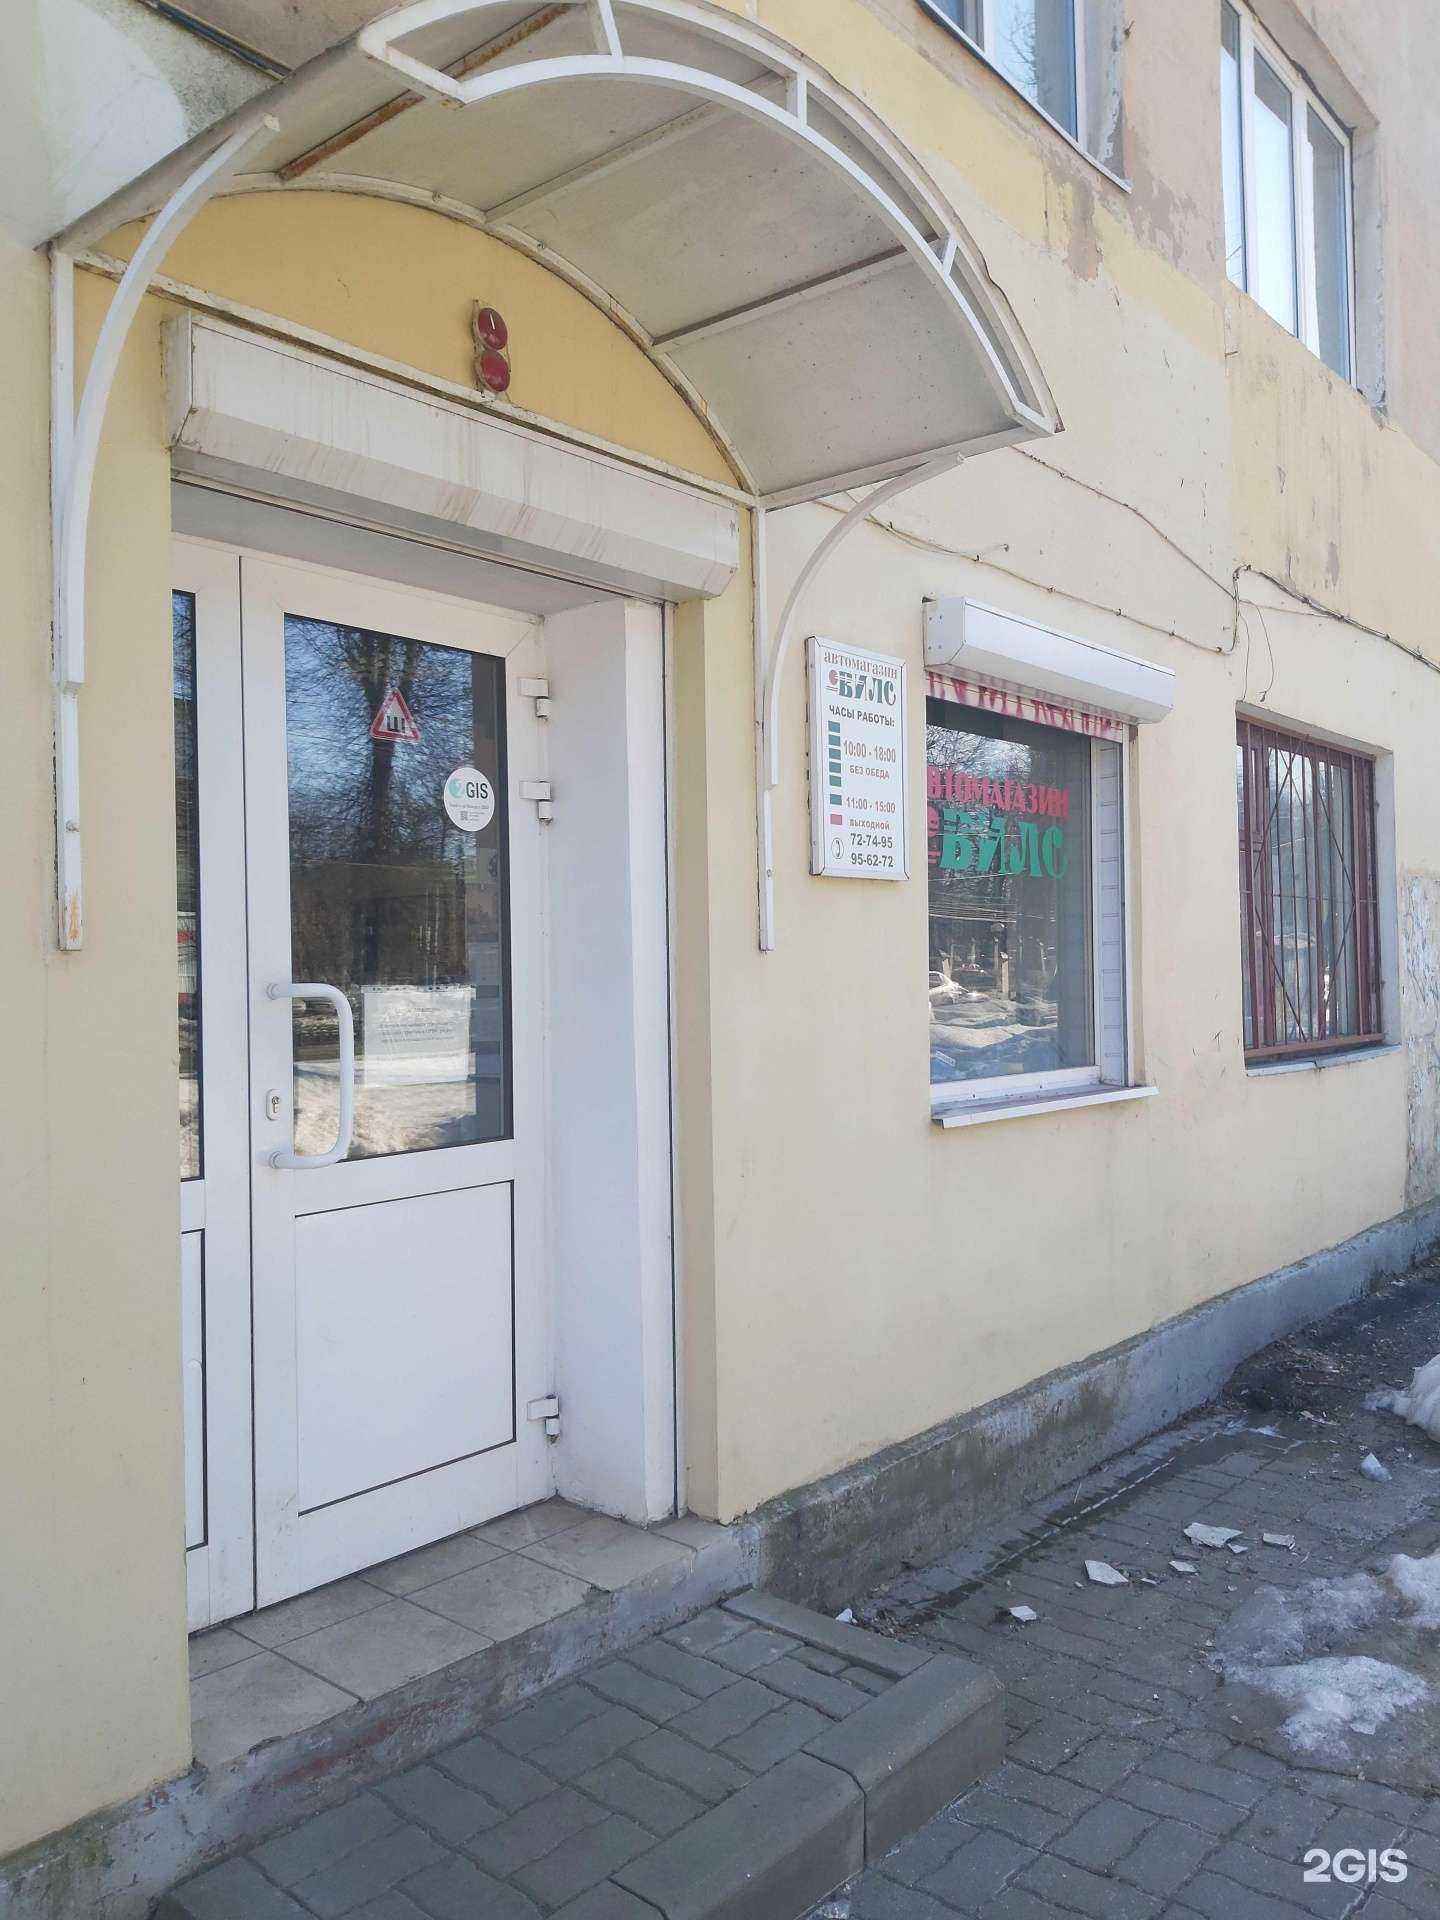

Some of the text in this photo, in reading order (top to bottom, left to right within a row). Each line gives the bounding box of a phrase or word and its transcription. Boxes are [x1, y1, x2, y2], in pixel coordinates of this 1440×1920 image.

[824, 651, 898, 680] автомагазин
[829, 704, 895, 727] ЧАСЫ РАБОТЫ:
[844, 740, 867, 758] 10:00
[875, 745, 896, 763] 18:00
[849, 764, 890, 779] БЕЗ ОБЕДА
[927, 764, 1069, 817] ВТОМАГАЗИН
[846, 796, 868, 810] 11:00
[850, 832, 893, 848] 72-74-95
[851, 852, 894, 868] 95-62-72
